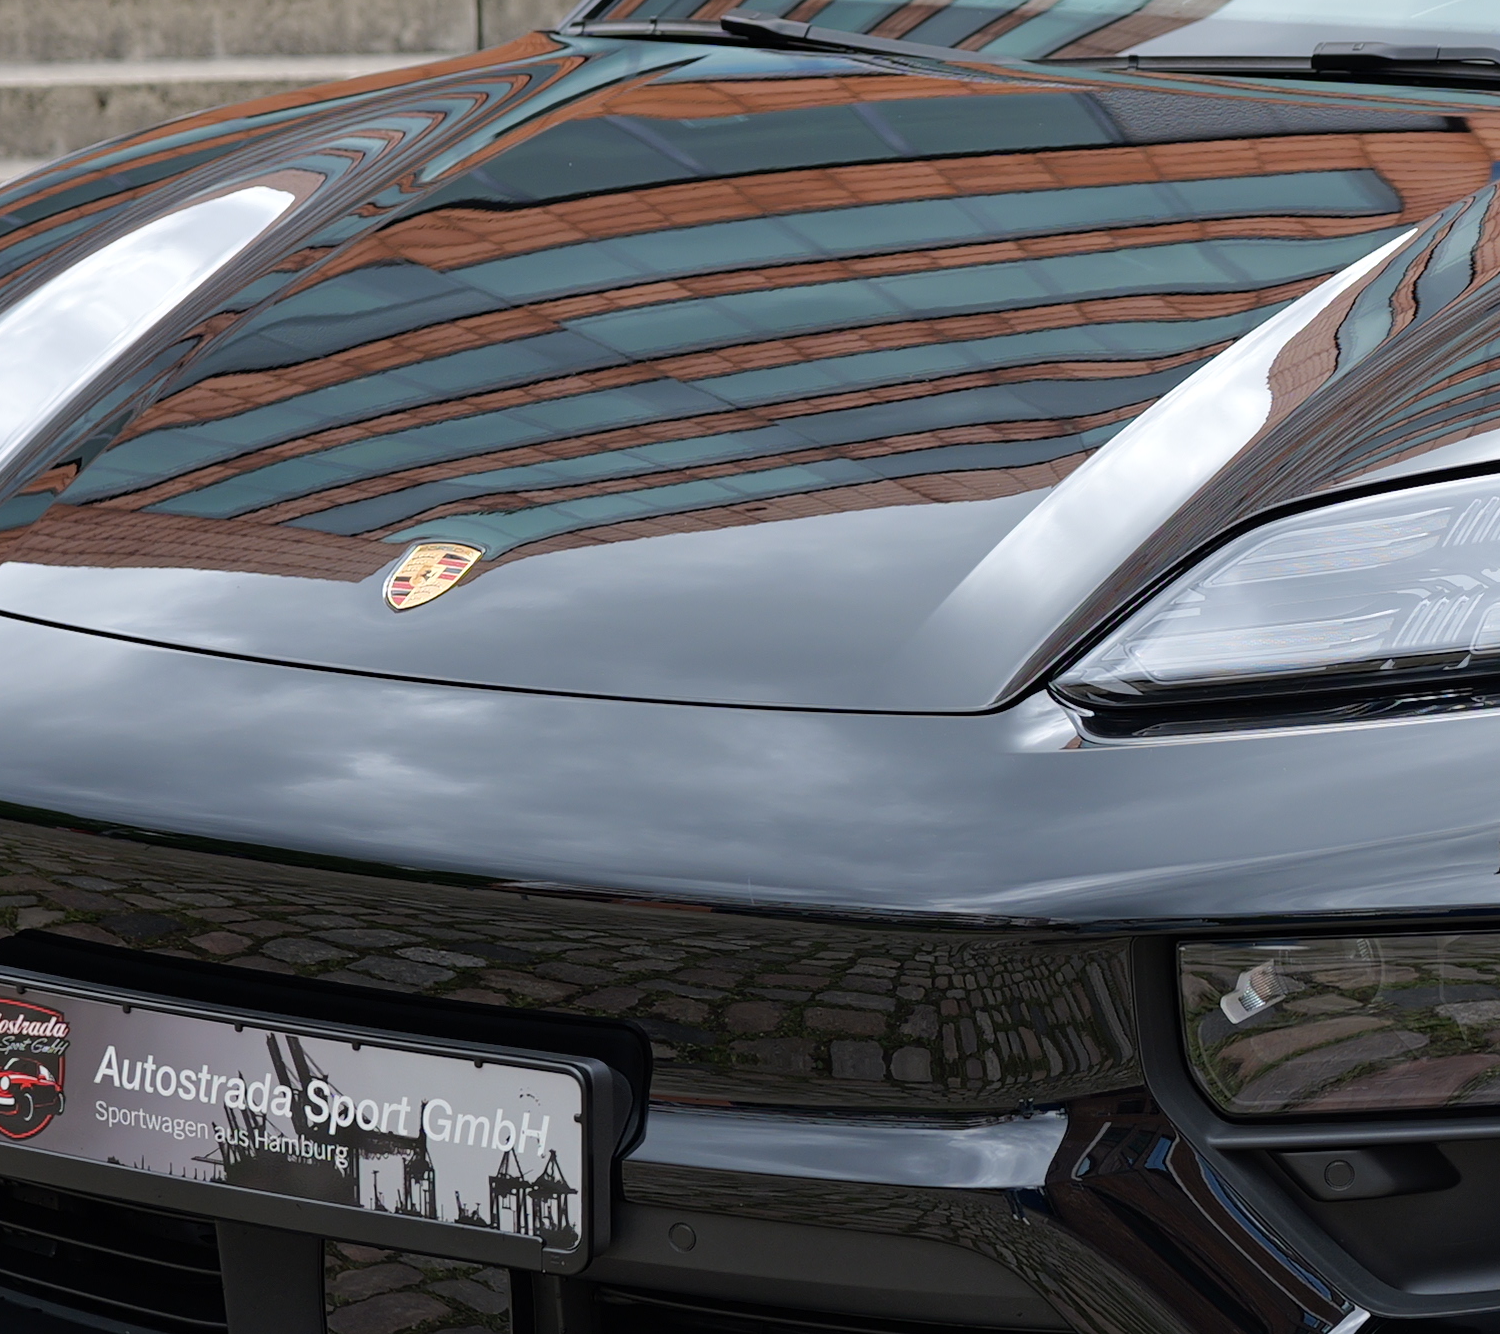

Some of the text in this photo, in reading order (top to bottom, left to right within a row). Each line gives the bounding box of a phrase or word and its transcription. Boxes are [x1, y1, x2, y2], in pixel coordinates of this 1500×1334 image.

[93, 1044, 551, 1157] Autostrada Sport GmbH
[95, 1099, 349, 1169] Sportwagen aus Hamburg
